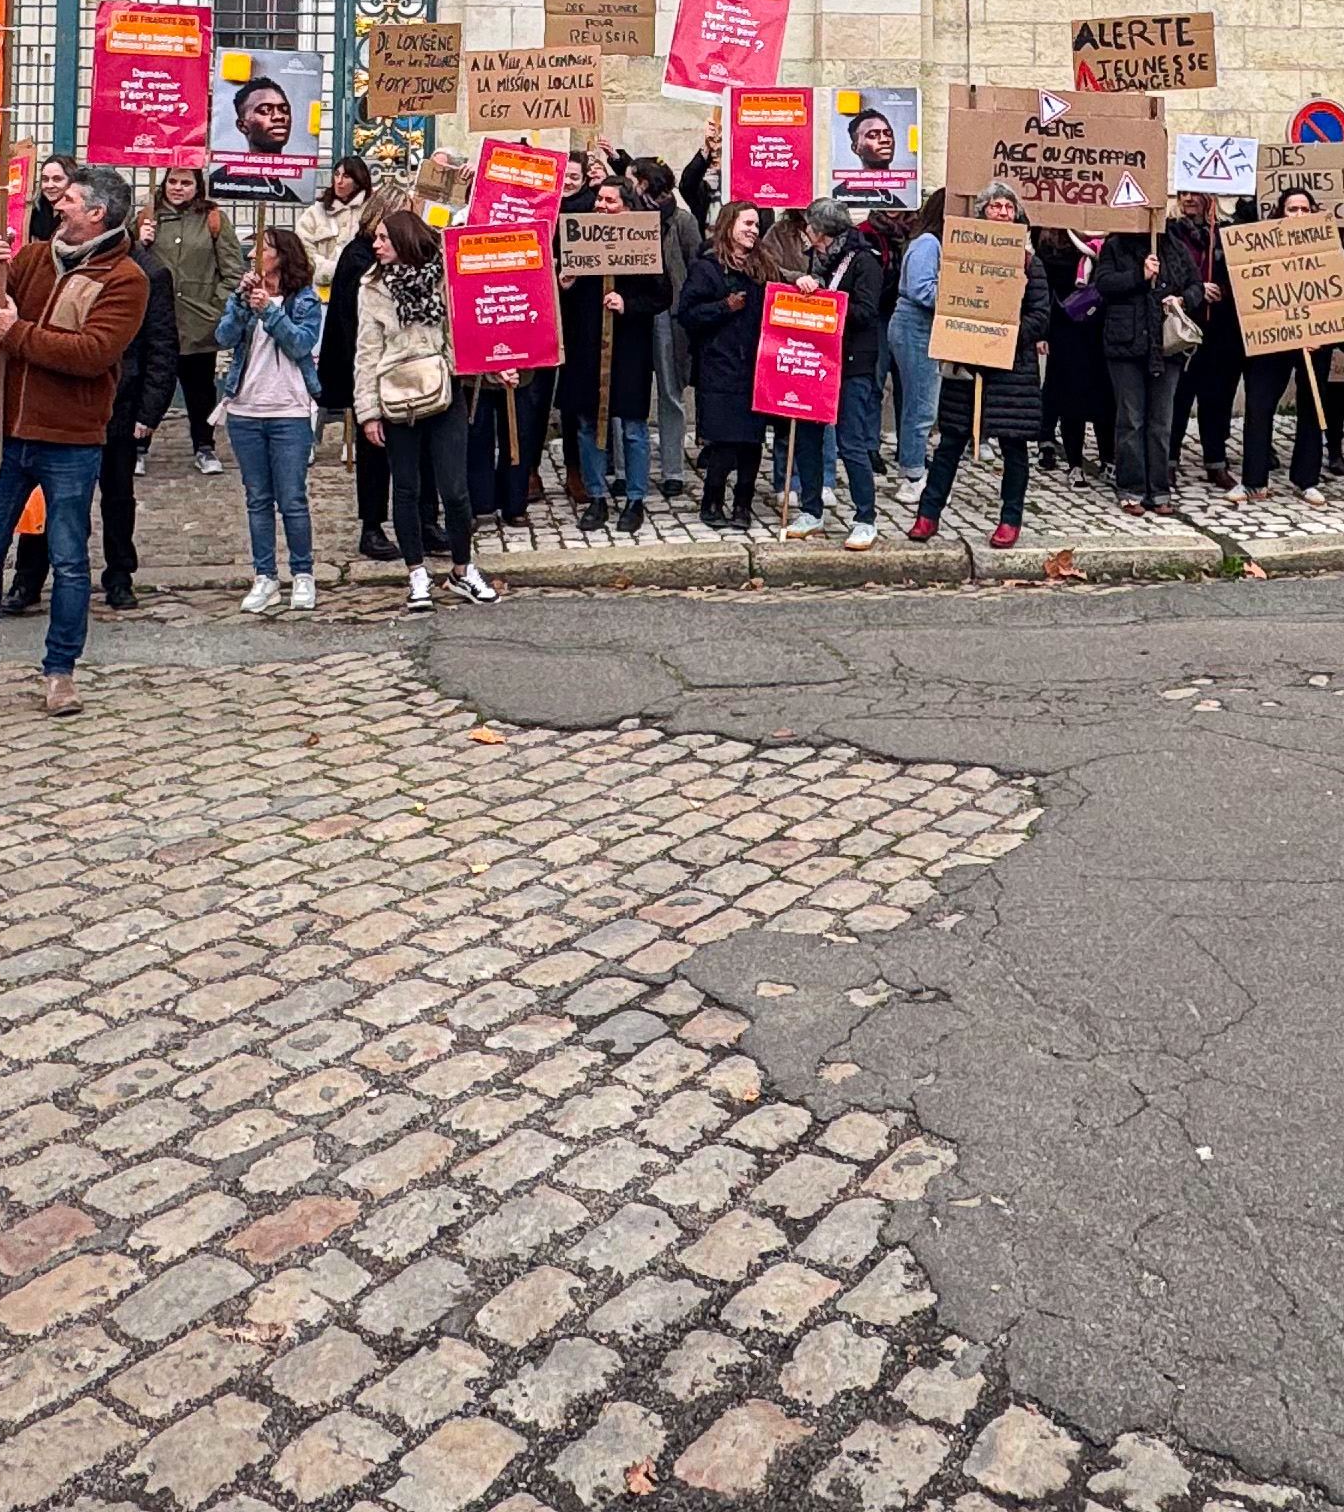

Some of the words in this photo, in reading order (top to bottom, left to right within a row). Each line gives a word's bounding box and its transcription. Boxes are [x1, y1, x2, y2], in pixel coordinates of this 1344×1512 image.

[586, 19, 614, 29] POUR
[1073, 17, 1195, 51] ALERTE
[484, 55, 496, 70] LA
[1097, 53, 1209, 81] JEUNESSE
[477, 77, 491, 93] LA
[497, 74, 539, 92] MISSION
[548, 73, 594, 90] LOCALE
[1115, 73, 1186, 90] DANGER
[1043, 148, 1061, 162] OU
[1182, 137, 1253, 176] ALERTE
[1265, 145, 1306, 168] DES
[994, 163, 1008, 178] LA
[1077, 170, 1103, 182] EN
[1022, 180, 1109, 206] DANGER
[1260, 171, 1334, 198] JEUNES
[566, 219, 625, 242] BUDGET
[951, 229, 988, 244] MISSION
[1226, 230, 1244, 246] LA
[1288, 225, 1334, 247] MENTALE
[959, 261, 974, 273] EN
[980, 264, 1018, 279] DANGER
[1281, 256, 1326, 272] VITAL
[948, 295, 989, 309] JEUNES
[1252, 275, 1343, 310] SAUVONS
[1285, 306, 1311, 320] LES
[1245, 324, 1303, 347] MISSIONS
